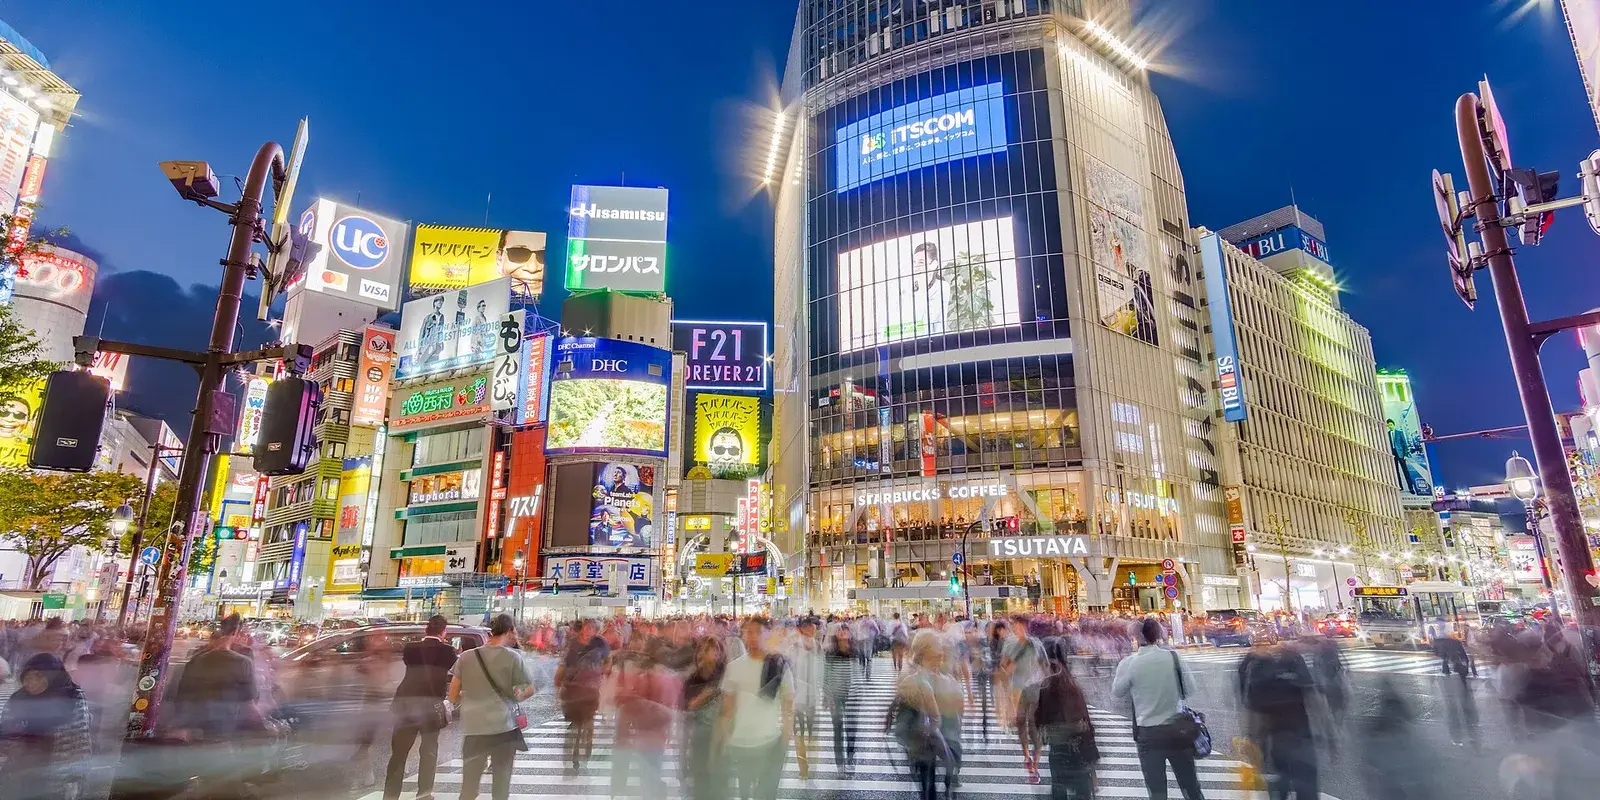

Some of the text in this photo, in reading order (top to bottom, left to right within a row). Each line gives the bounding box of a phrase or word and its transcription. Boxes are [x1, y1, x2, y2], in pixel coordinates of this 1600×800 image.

[570, 203, 665, 221] Hisamitsu
[420, 242, 494, 260] ヤバババーン
[571, 254, 660, 275] サロンパス
[364, 284, 388, 298] VISA
[404, 340, 417, 351] ALL
[438, 330, 457, 342] BEST
[458, 320, 501, 338] 1998-2018
[692, 328, 743, 361] F21
[558, 342, 596, 351] DHC Channel
[493, 314, 522, 406] もんじゃ
[591, 359, 628, 373] DHC
[685, 365, 761, 382] OREVER 21
[1217, 355, 1241, 410] SEIBU
[700, 398, 756, 415] ヤバババーン
[412, 487, 460, 504] Euphoria
[604, 496, 641, 508] Planets
[857, 484, 1008, 506] STARBUCKS COFFEE
[506, 484, 543, 538] クスリ
[739, 529, 747, 554] カラオ
[990, 537, 1088, 558] TSUTAYA
[551, 561, 645, 582] 大盛堂店
